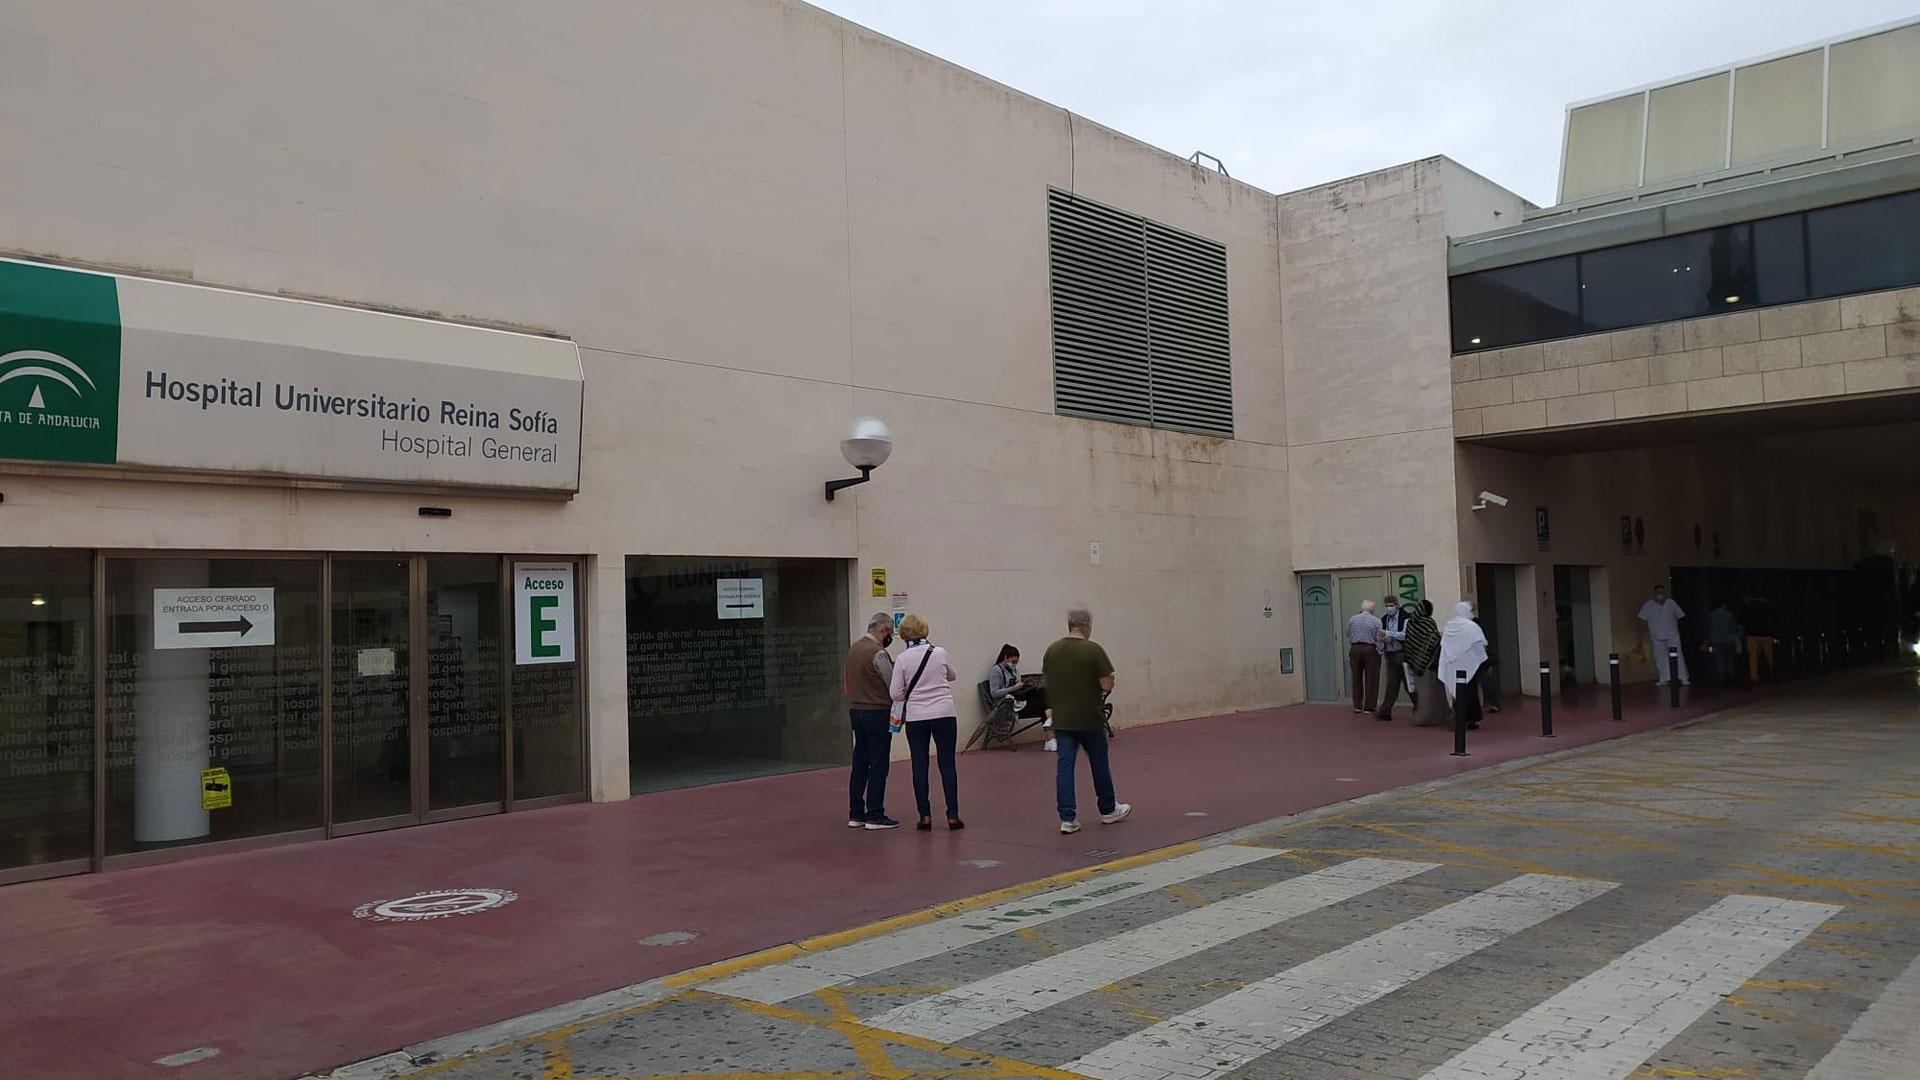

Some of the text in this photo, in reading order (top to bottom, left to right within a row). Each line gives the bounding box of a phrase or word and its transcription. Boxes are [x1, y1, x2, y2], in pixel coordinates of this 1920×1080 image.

[145, 370, 558, 434] Hospital Universitario Reina Sofía
[18, 412, 33, 425] DE
[38, 413, 100, 429] ANDALUCIA
[381, 429, 558, 464] Hospital General
[524, 576, 564, 590] Acceso
[176, 594, 257, 604] ACCESO CERRADO
[162, 605, 203, 614] ENTRADA
[205, 604, 224, 613] POR
[226, 604, 261, 613] ACCESO
[530, 595, 561, 658] E
